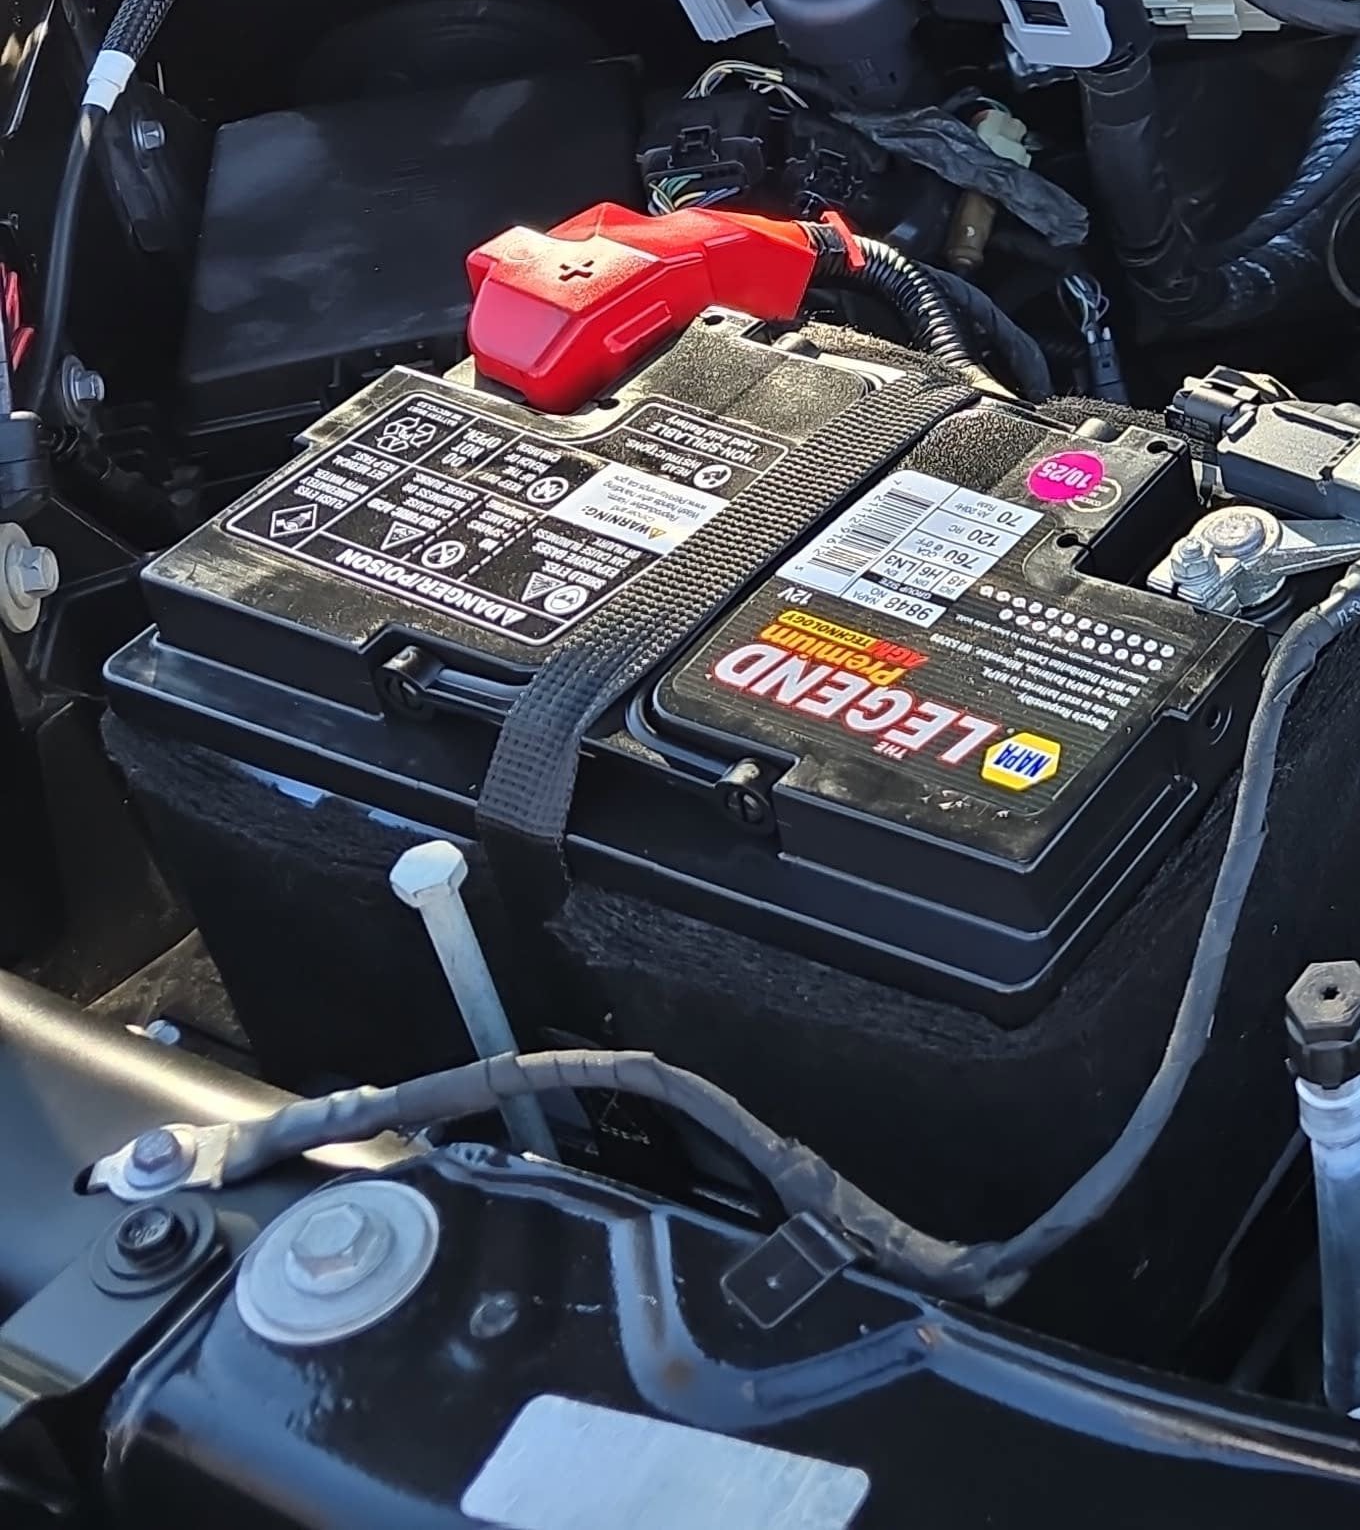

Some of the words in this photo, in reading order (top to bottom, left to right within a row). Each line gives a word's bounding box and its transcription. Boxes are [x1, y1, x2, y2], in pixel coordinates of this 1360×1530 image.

[661, 414, 711, 435] Battery
[456, 427, 505, 449] OPEN.
[641, 420, 758, 463] NON-SPILLABLE
[702, 430, 732, 443] Acid
[727, 436, 761, 451] Lead
[447, 439, 487, 458] NOT
[369, 459, 400, 473] HELP
[438, 451, 469, 467] DO
[365, 468, 389, 480] GET
[657, 461, 693, 476] READ
[1034, 457, 1096, 491] 10/25
[340, 479, 371, 494] WITH
[313, 493, 349, 510] FLUSH
[400, 495, 437, 512] CAUSE
[429, 506, 456, 519] CAN
[576, 504, 652, 534] WARNING:
[994, 509, 1024, 527] 70
[946, 523, 966, 535] RC
[964, 526, 1003, 548] 120
[578, 544, 614, 561] CAUSE
[914, 545, 939, 558] CCA
[940, 547, 981, 570] 760
[561, 552, 622, 578] EXPLOSIVE
[607, 554, 633, 568] CAN
[882, 552, 918, 572] LN3
[564, 569, 609, 590] SHIELD
[881, 566, 900, 578] EN
[917, 564, 943, 579] H6
[946, 573, 969, 588] 48
[333, 547, 510, 620] DANGER/POISON
[876, 576, 902, 590] SIZE
[898, 583, 933, 600] GROUP
[775, 583, 816, 606] 12V
[849, 589, 881, 606] NAPA
[881, 594, 935, 622] 9848
[779, 609, 874, 648] TECHNOLOGY
[752, 622, 908, 688] Premium
[865, 637, 930, 670] AGM
[1012, 645, 1050, 665] Centers
[1046, 657, 1101, 683] Distribution
[1016, 677, 1061, 701] batteries
[1064, 677, 1094, 694] NAPA
[1090, 684, 1107, 698] by
[1098, 674, 1128, 692] NAPA
[1123, 682, 1141, 696] for
[701, 635, 1003, 770] LEGEND
[1056, 692, 1083, 708] used
[1079, 699, 1093, 711] in
[1068, 709, 1110, 731] Recycle
[1089, 702, 1119, 720] Trade
[870, 738, 910, 761] THE
[991, 741, 1052, 780] NAPA
